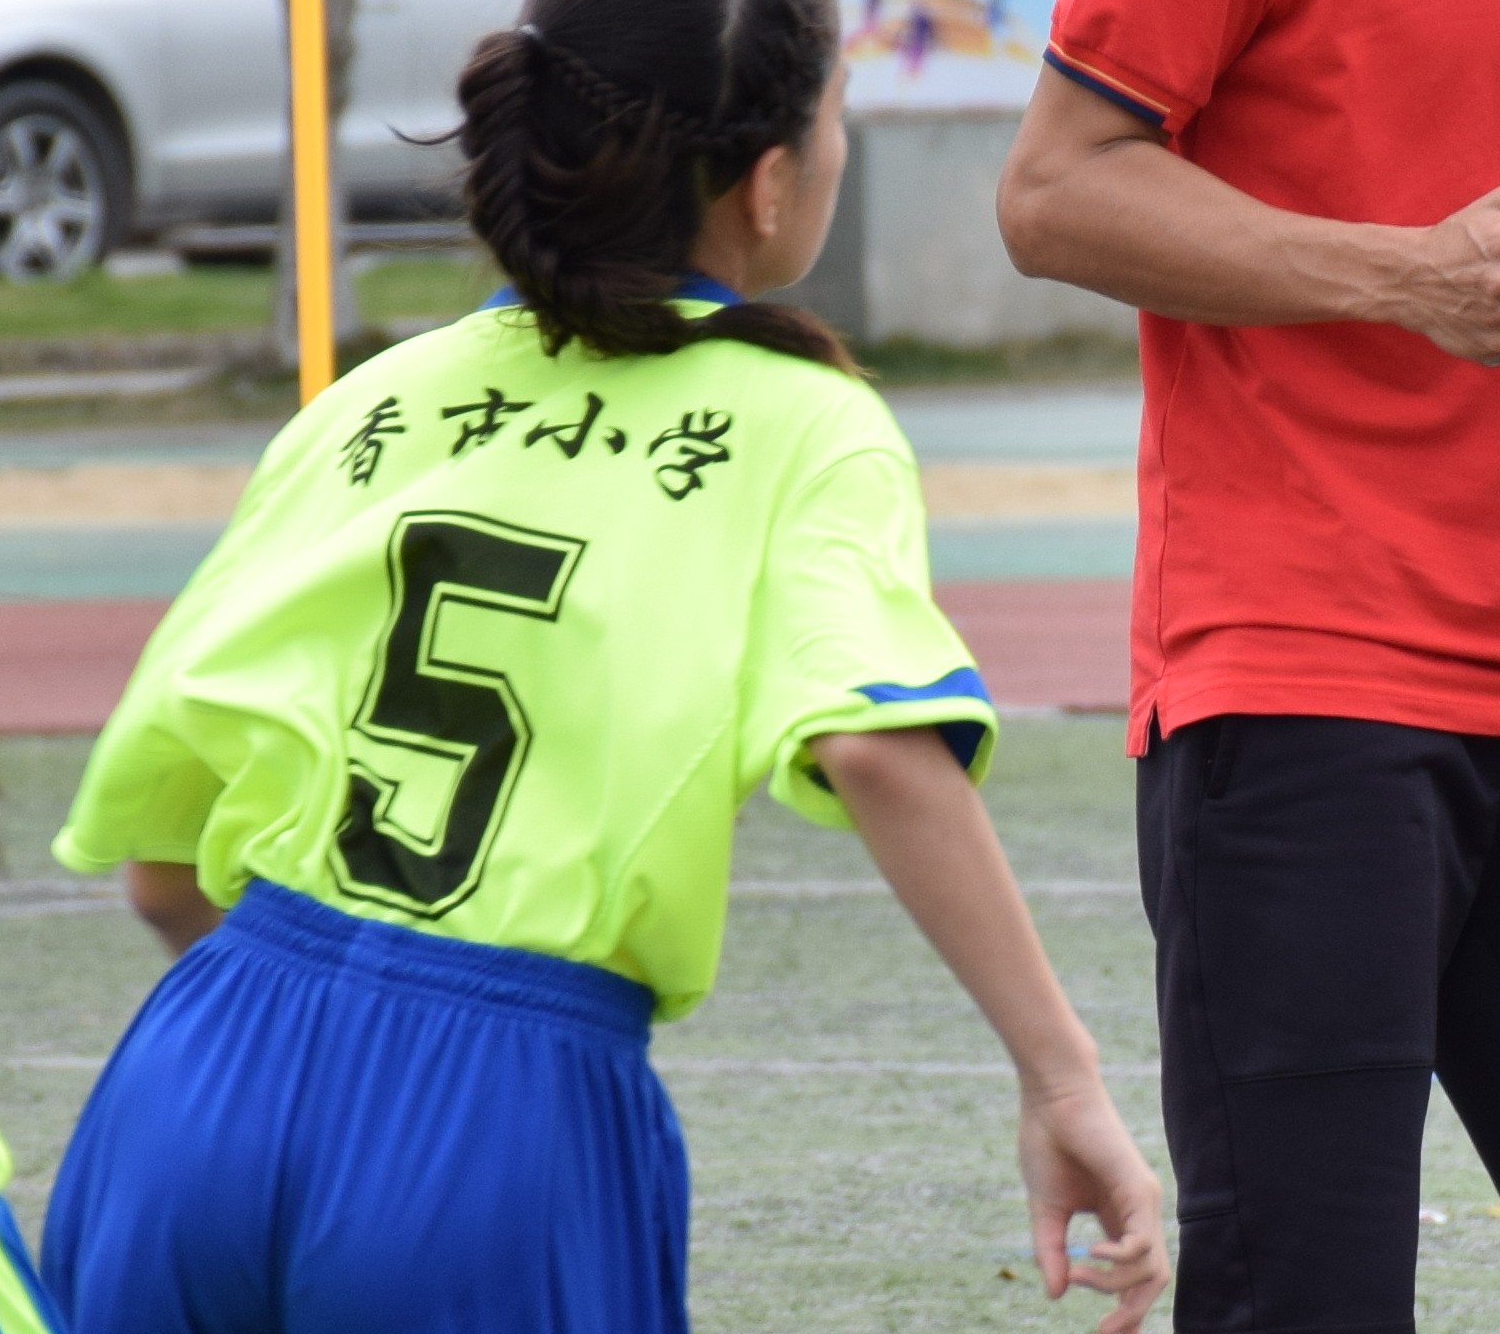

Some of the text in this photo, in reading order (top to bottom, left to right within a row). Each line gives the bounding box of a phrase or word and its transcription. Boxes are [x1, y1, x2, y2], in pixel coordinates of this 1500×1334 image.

[338, 386, 734, 502] 香市小学
[327, 509, 587, 919] 5
